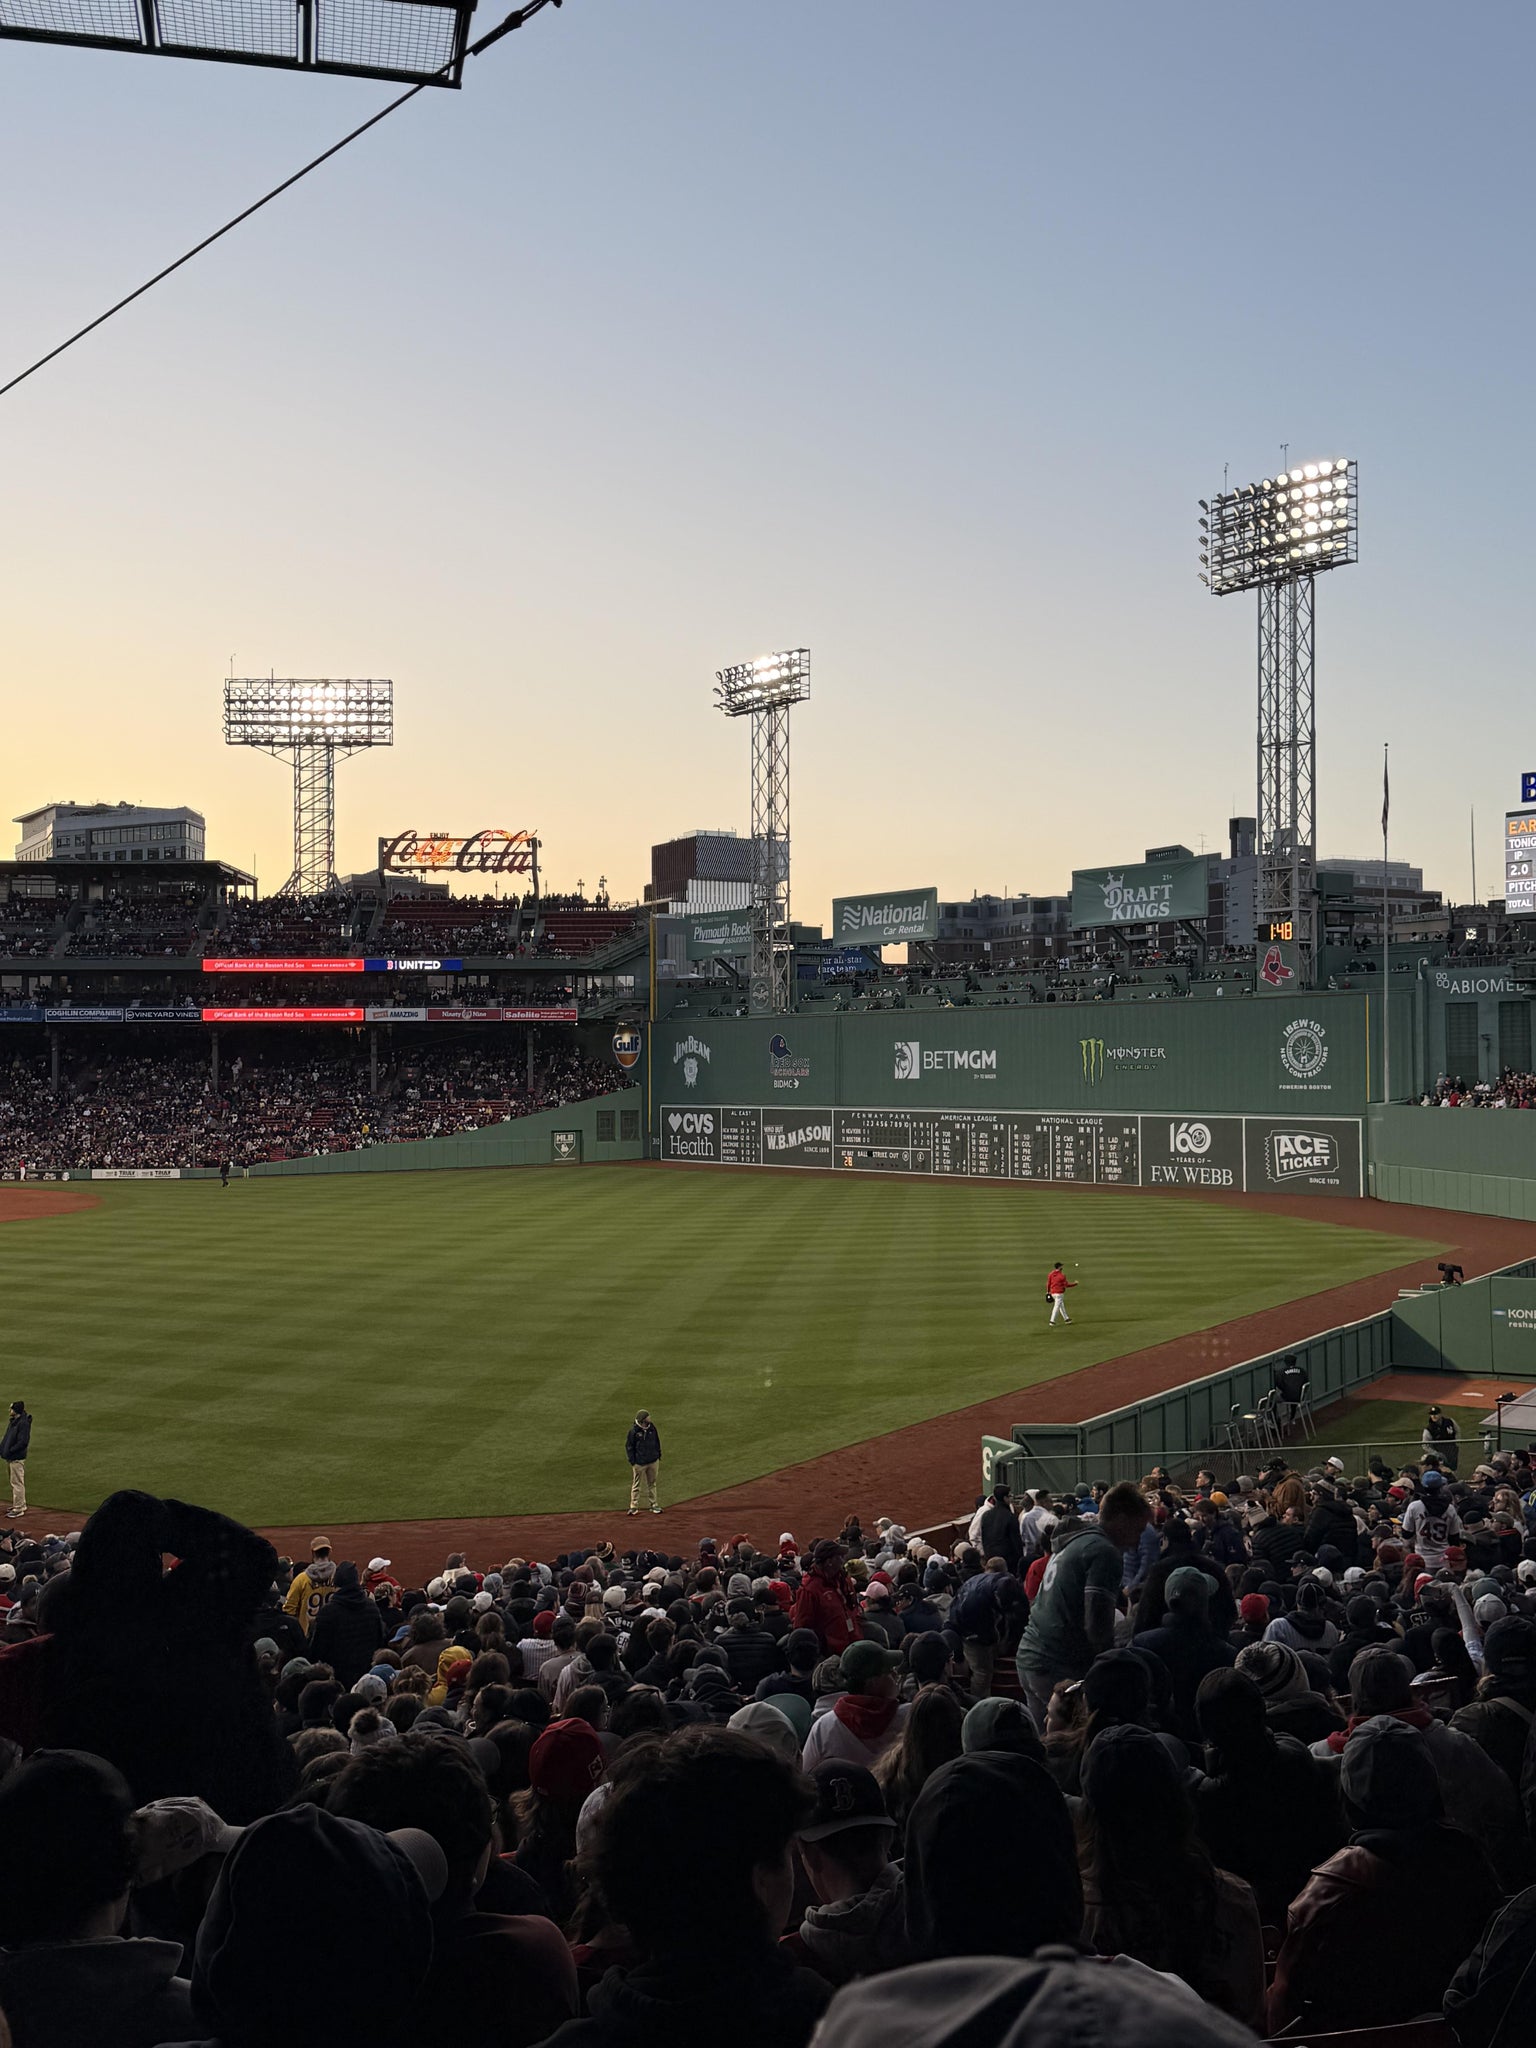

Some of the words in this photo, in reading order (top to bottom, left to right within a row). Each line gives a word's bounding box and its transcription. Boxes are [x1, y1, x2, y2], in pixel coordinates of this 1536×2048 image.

[1514, 850, 1523, 860] IP
[1510, 863, 1528, 876] 2.0
[1104, 884, 1173, 909] DRAFT
[1508, 899, 1533, 909] TOTAL
[861, 900, 928, 926] National
[1111, 902, 1170, 921] KINGS
[693, 923, 730, 941] Plymouth
[731, 921, 751, 936] Rock
[883, 927, 897, 935] Car
[898, 923, 925, 934] Rental
[399, 960, 442, 970] UNITED
[1283, 1019, 1309, 1037] IBEW
[1309, 1020, 1326, 1037] 103
[614, 1036, 641, 1052] Gulf
[688, 1035, 711, 1064] BEAM
[923, 1050, 997, 1069] BETMGM
[682, 1112, 714, 1134] CVS
[669, 1134, 715, 1157] Health
[1169, 1122, 1212, 1154] 160
[1279, 1135, 1330, 1157] ACE
[1280, 1155, 1330, 1171] TICKET
[1151, 1165, 1179, 1182] F.W.
[1183, 1167, 1233, 1185] WEBB
